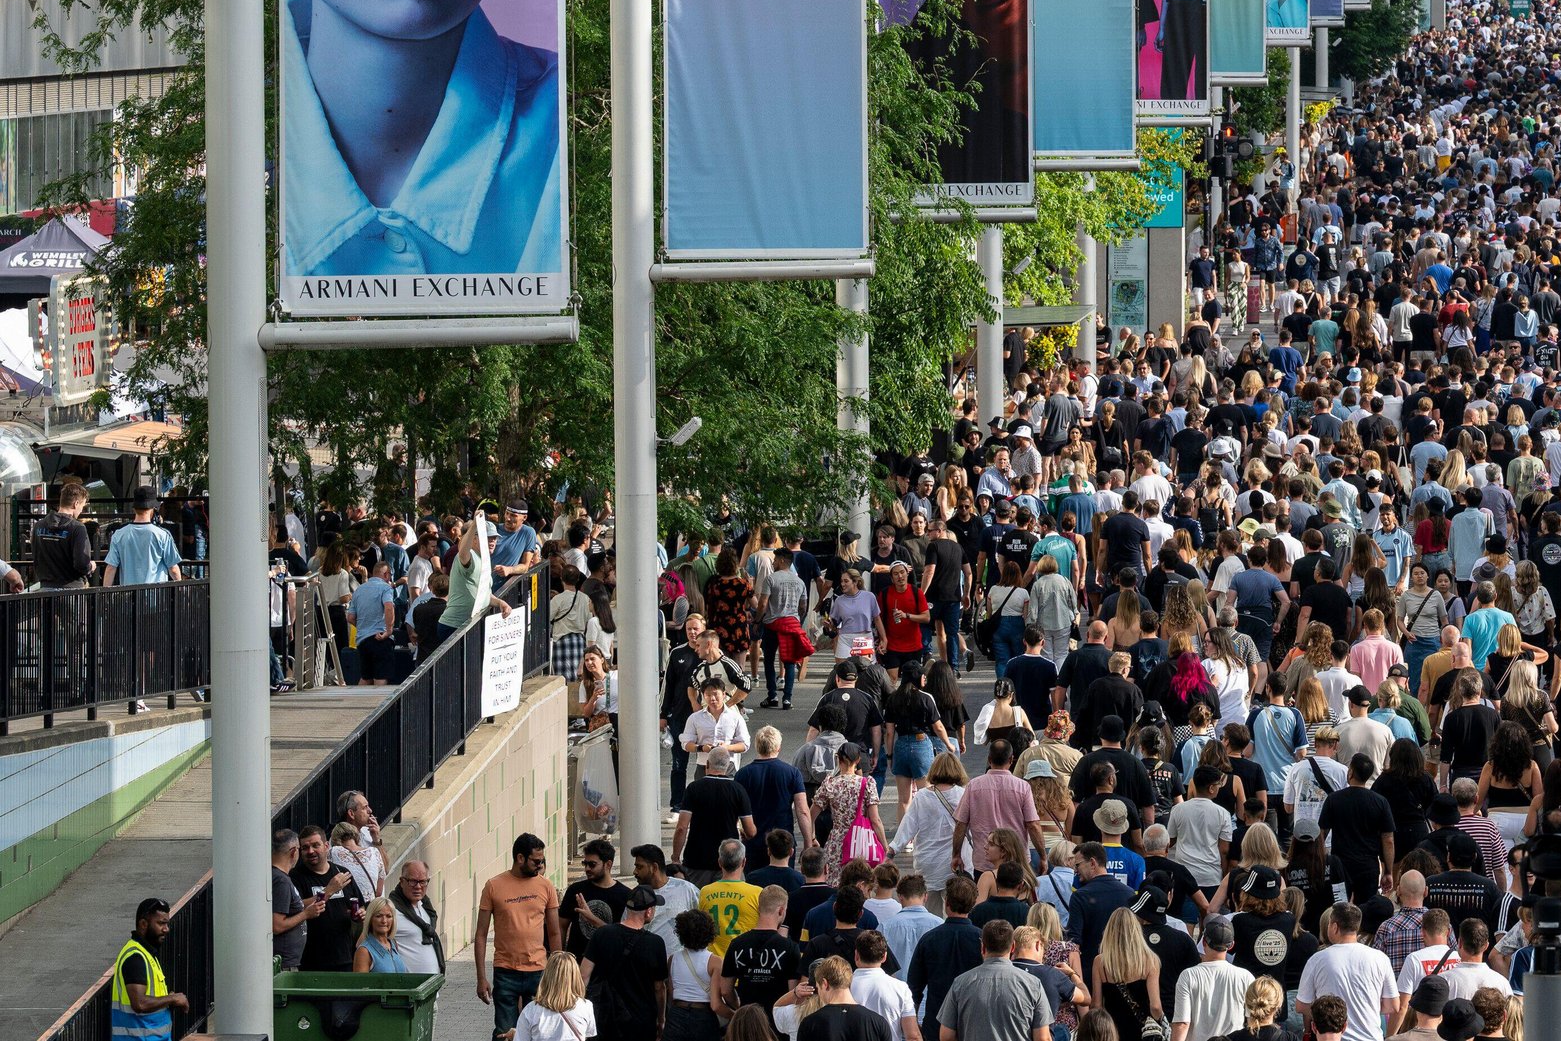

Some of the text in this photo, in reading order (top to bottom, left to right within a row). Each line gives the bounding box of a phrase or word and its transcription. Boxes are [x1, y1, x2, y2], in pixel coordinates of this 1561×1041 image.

[1151, 100, 1202, 109] EXCHANGE
[948, 185, 1023, 197] EXCHANGE
[32, 252, 87, 260] WEMBLEY
[29, 259, 84, 269] GRILL
[299, 275, 549, 299] ARMANI EXCHANGE
[706, 891, 744, 902] TWENTY
[710, 903, 740, 935] 12
[734, 948, 786, 970] KOX
